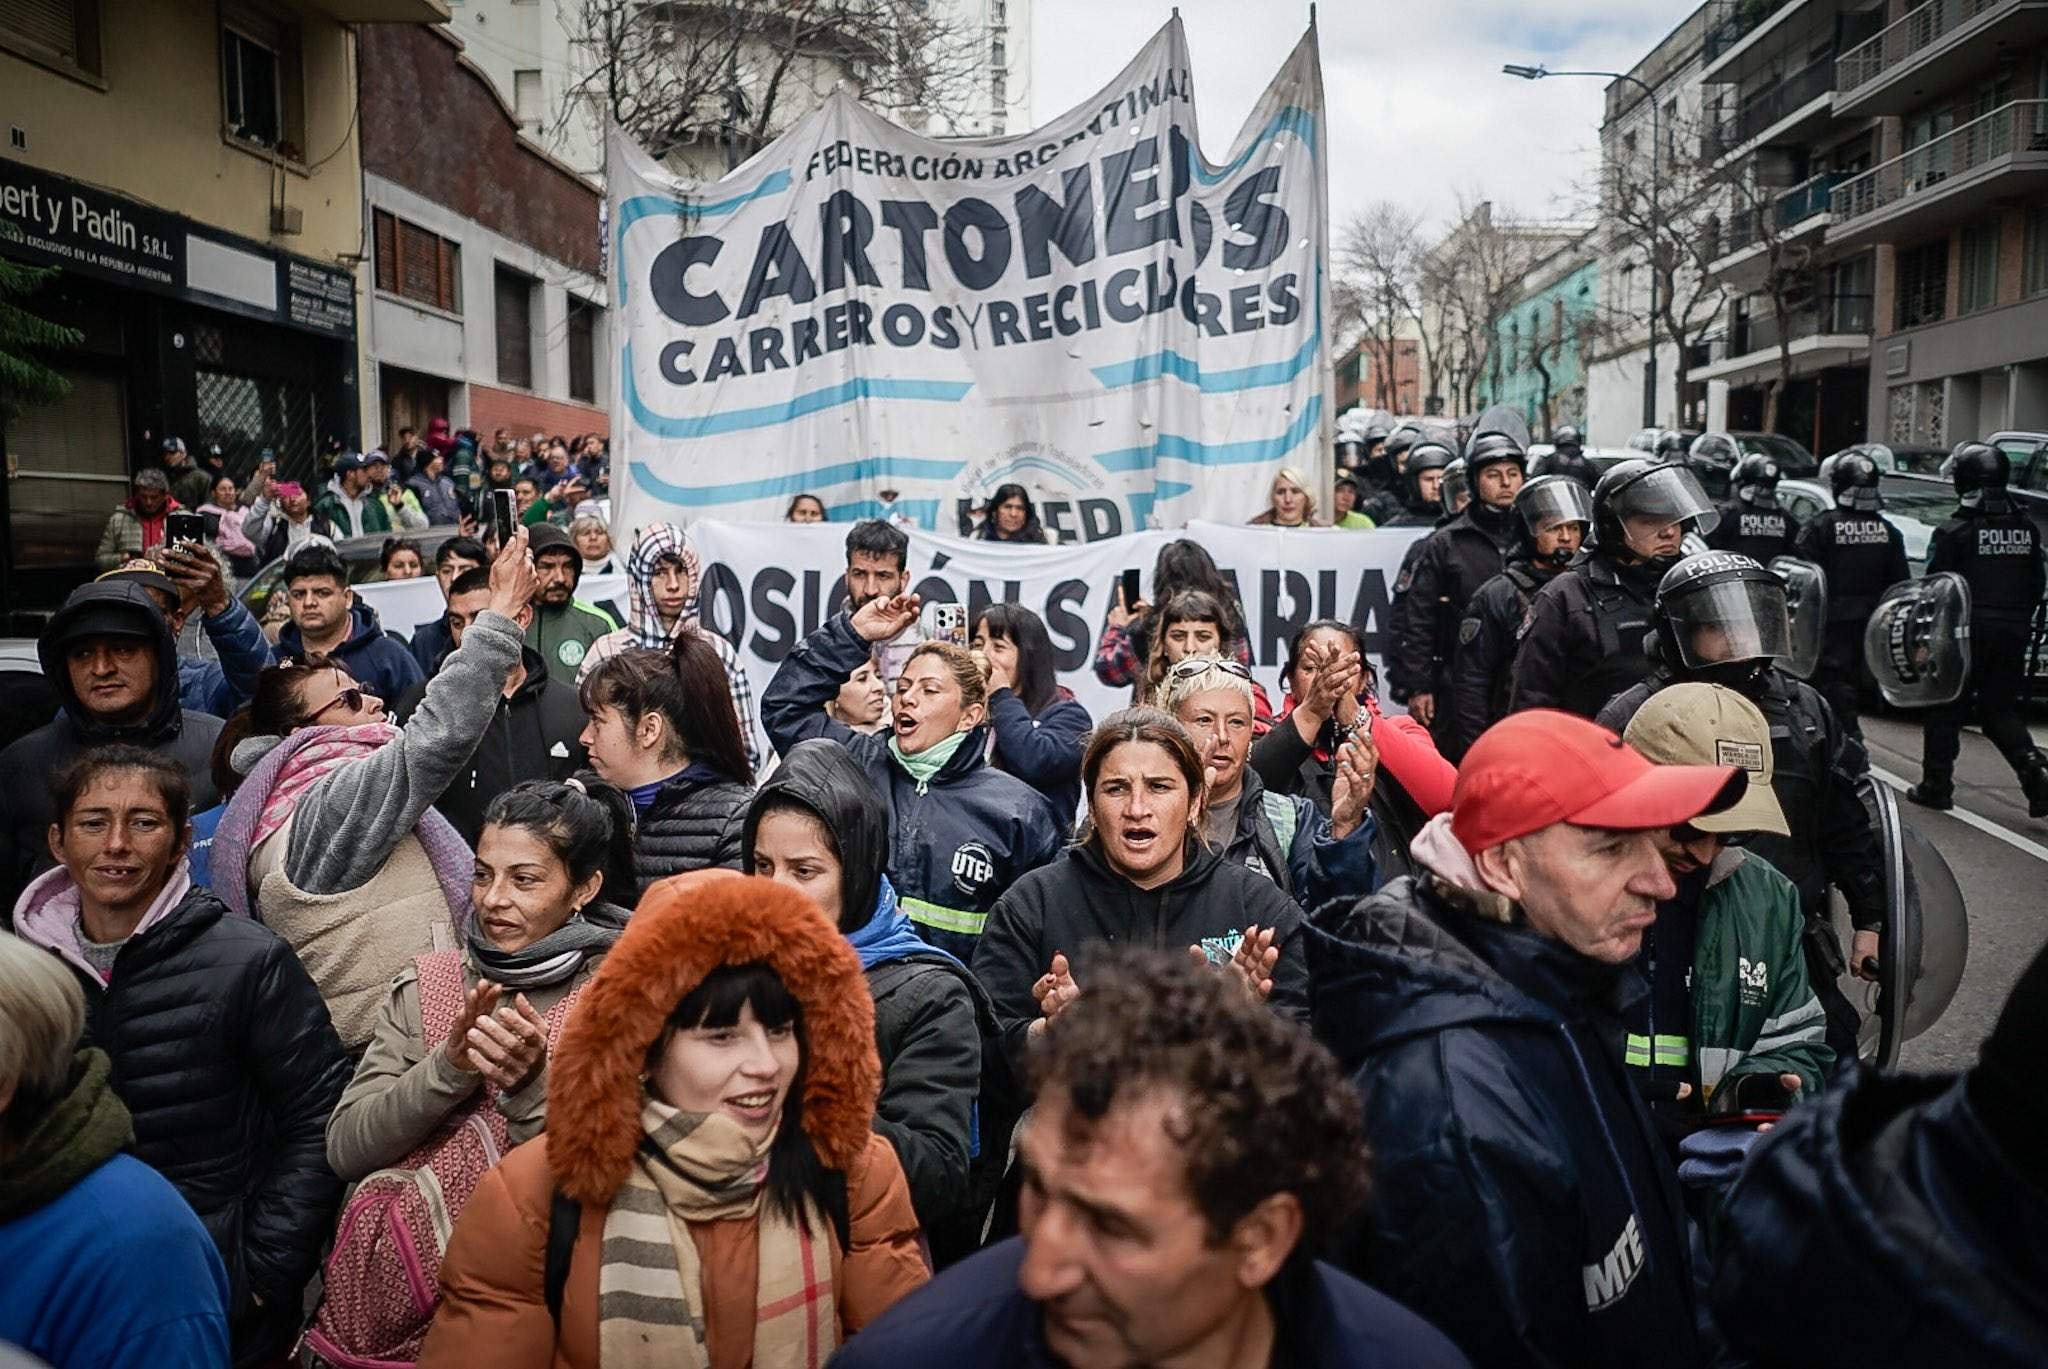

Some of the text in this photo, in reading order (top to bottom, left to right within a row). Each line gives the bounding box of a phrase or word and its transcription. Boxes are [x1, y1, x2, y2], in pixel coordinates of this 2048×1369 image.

[804, 139, 984, 182] FEDERACIÓN
[0, 184, 42, 222] ert
[47, 197, 63, 235] y
[71, 195, 137, 250] Padin
[27, 234, 73, 258] EXCLUSIVOS
[74, 247, 86, 262] EN
[86, 252, 98, 265] LA
[658, 298, 961, 386] CARREROS
[957, 302, 981, 351] Y
[1740, 514, 1786, 529] POLICIA
[1835, 521, 1888, 536] POLICIA
[1836, 535, 1847, 544] DE
[1849, 535, 1860, 544] LA
[1978, 528, 2032, 545] POLICIA
[1979, 545, 1993, 555] DE
[1993, 545, 2006, 555] LA
[1684, 554, 1765, 577] POLICIA
[951, 851, 994, 884] UTEP
[1582, 1214, 1643, 1306] MTE
